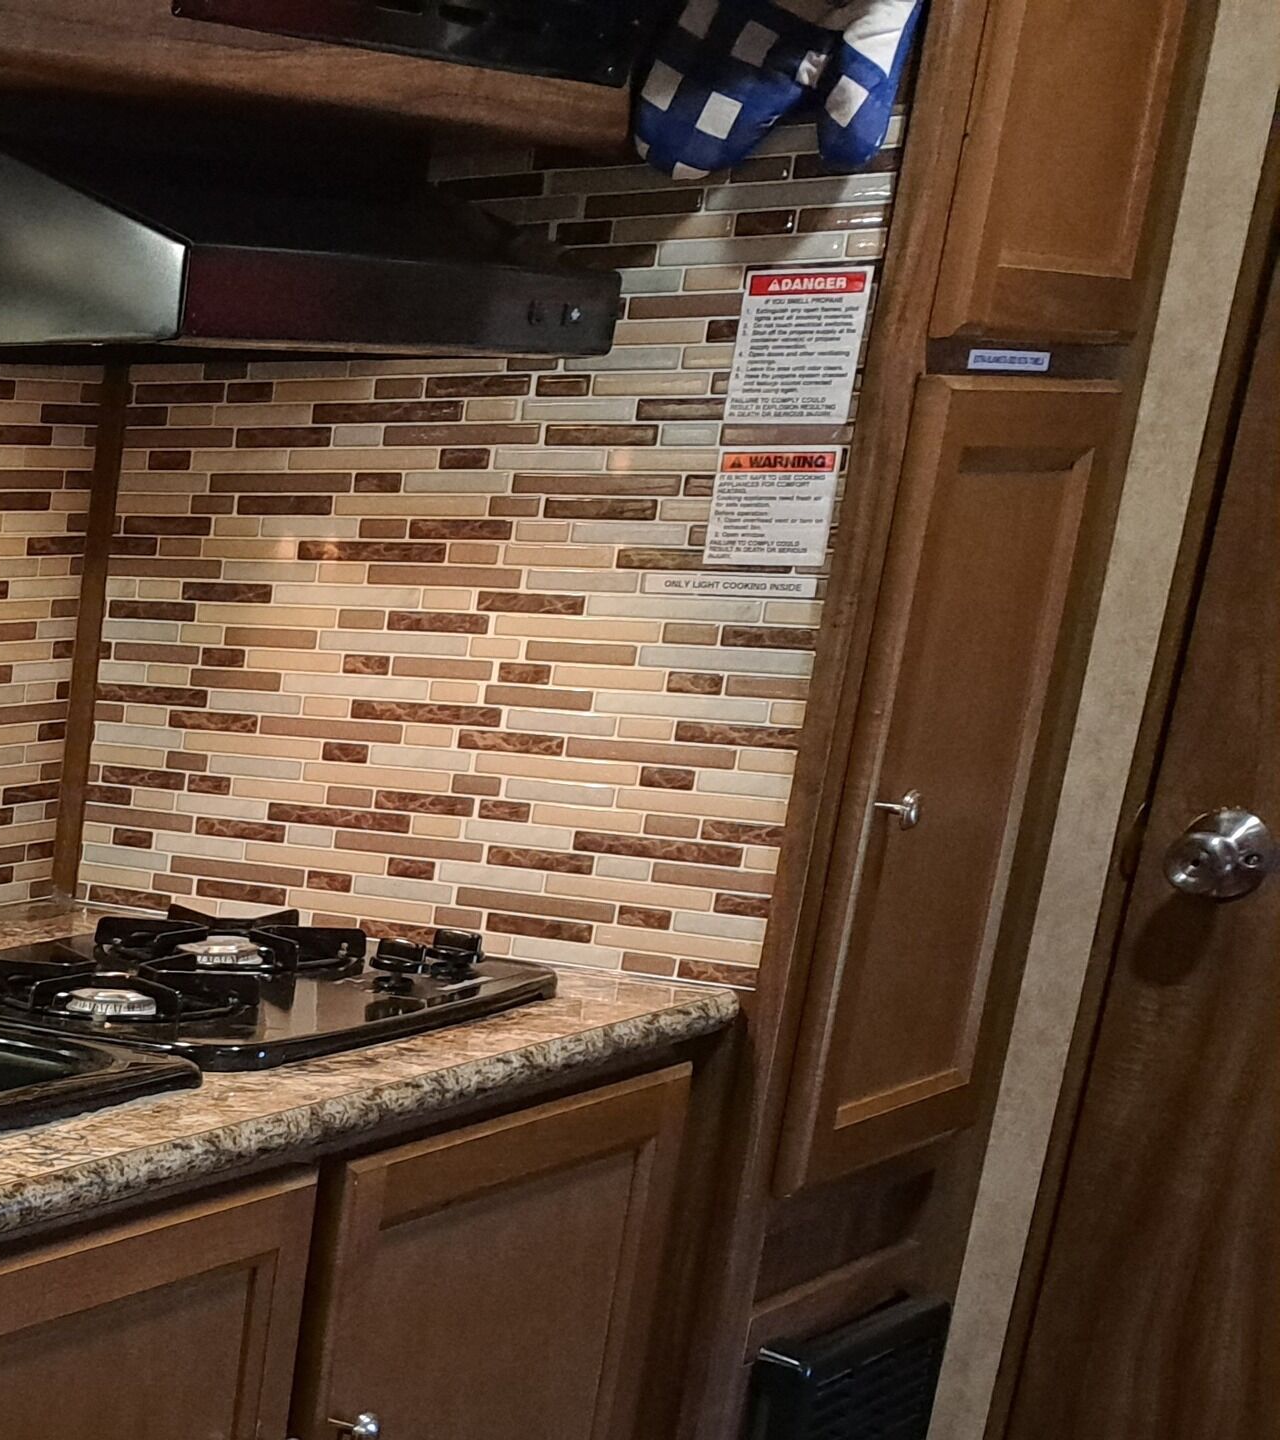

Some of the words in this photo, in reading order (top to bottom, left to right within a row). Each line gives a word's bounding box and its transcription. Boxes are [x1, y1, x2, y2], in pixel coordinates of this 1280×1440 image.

[780, 277, 847, 290] DANGER
[750, 456, 826, 468] WARNING
[664, 580, 689, 588] ONLY
[692, 581, 720, 589] LIGHT
[722, 582, 767, 590] COOKING
[770, 584, 802, 592] INSIDE
